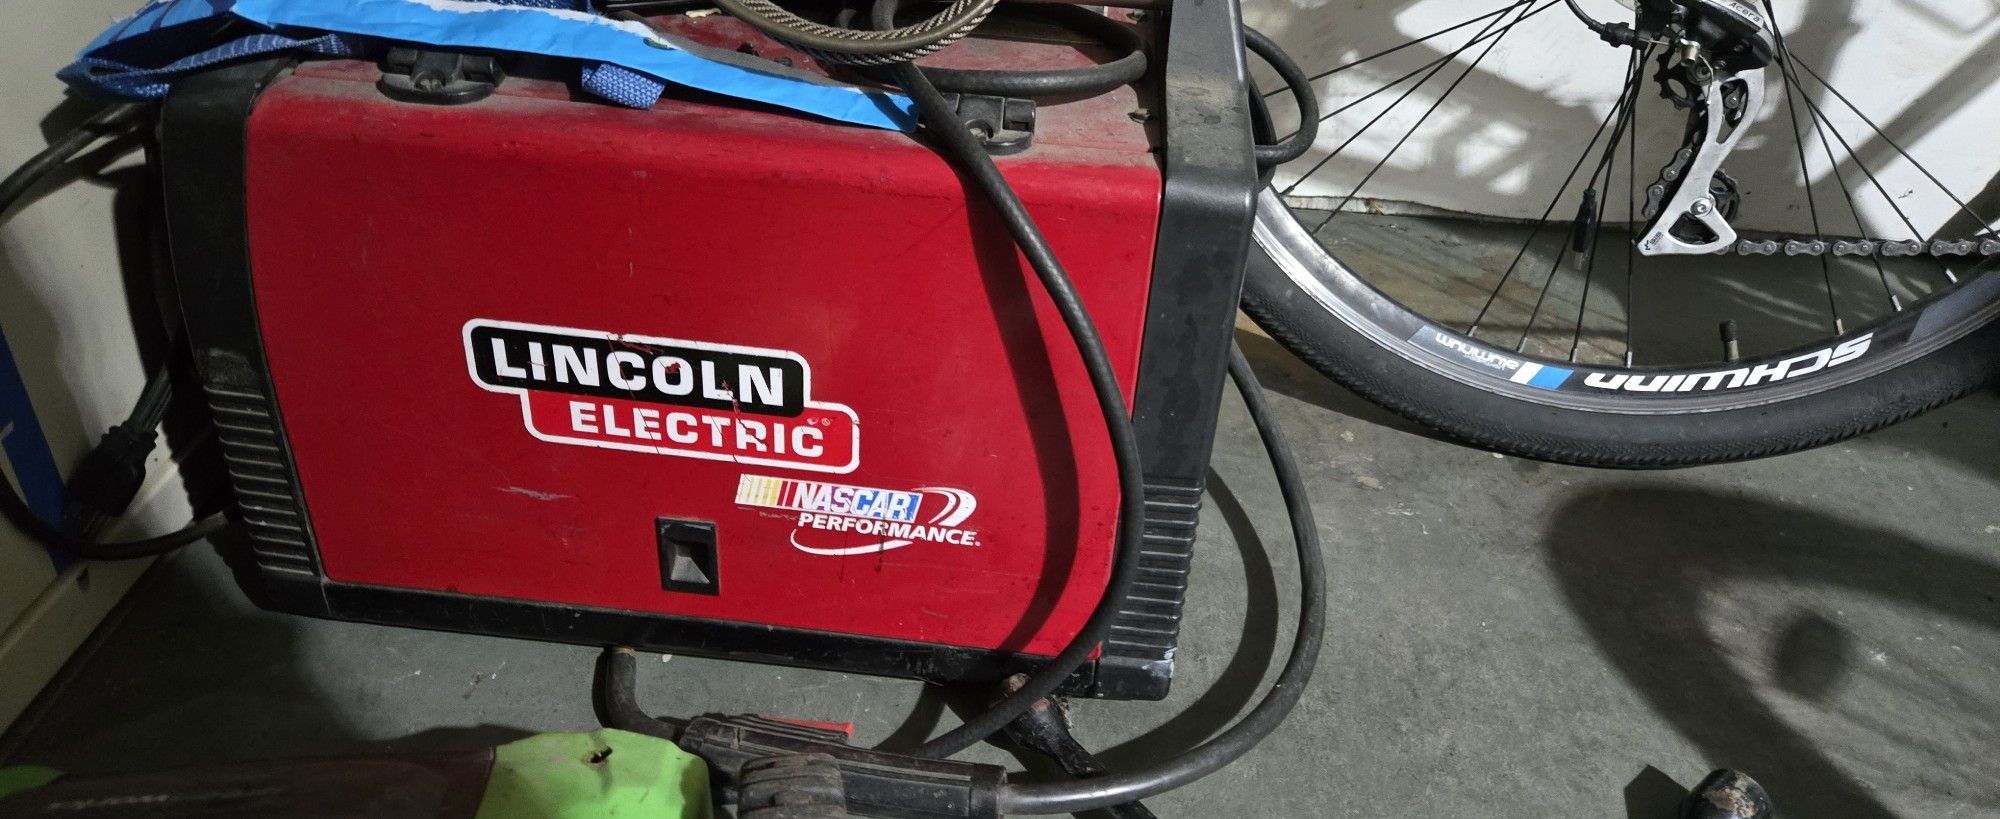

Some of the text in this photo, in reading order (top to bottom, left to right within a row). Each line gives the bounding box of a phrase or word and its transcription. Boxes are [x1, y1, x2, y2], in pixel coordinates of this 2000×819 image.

[491, 337, 784, 407] LINCOLN
[1584, 332, 1874, 392] SCHWINN
[569, 400, 824, 458] ELECTRIC
[793, 481, 913, 521] NASCAR
